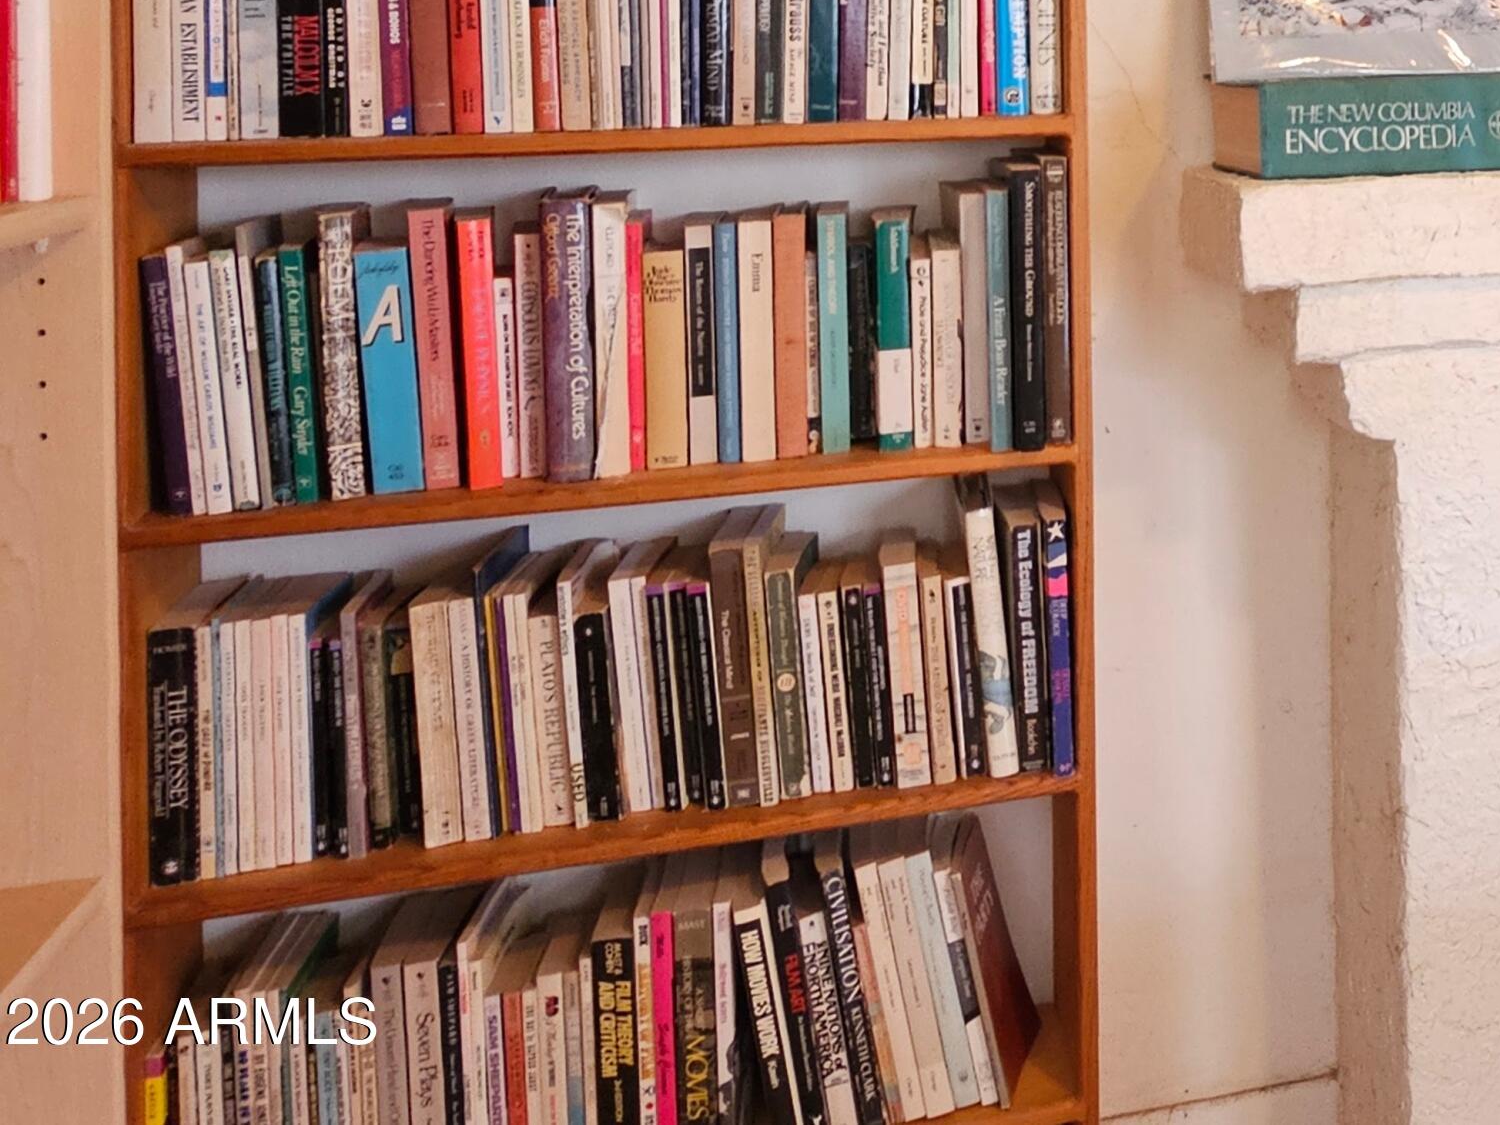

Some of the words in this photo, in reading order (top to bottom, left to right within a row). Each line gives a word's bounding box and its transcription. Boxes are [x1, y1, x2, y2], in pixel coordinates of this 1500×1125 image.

[281, 16, 292, 38] THE
[282, 44, 293, 64] FBI
[294, 15, 320, 82] MALCOLM
[180, 23, 199, 123] ESTABLISHMENT
[282, 69, 294, 96] FILE
[295, 85, 320, 96] X
[1287, 105, 1323, 125] THE
[1327, 103, 1375, 123] NEW
[1378, 101, 1475, 122] COLUMBIA
[1285, 124, 1476, 155] ENCYCLOPEDIA
[566, 213, 582, 242] The
[1025, 181, 1035, 245] SMOOTHING
[547, 213, 559, 256] Clifford
[283, 265, 299, 288] Left
[751, 253, 764, 293] Emma
[1025, 248, 1034, 268] THE
[285, 290, 299, 314] Out
[567, 246, 586, 352] Interpretation
[1025, 270, 1036, 316] GROUND
[287, 316, 299, 326] in
[361, 285, 403, 347] A
[287, 328, 301, 345] the
[290, 347, 305, 373] Rain
[567, 355, 587, 374] of
[290, 386, 308, 416] Gary
[570, 376, 588, 441] Cultures
[293, 418, 312, 455] Snyder
[1017, 530, 1031, 558] The
[1016, 561, 1033, 617] Ecology
[1021, 621, 1035, 636] of
[540, 641, 563, 704] PLATO'S
[1022, 639, 1038, 714] FREEDOM
[168, 685, 188, 725] THE
[168, 728, 188, 810] ODYSSEY
[544, 709, 566, 794] REPUBLIC
[571, 763, 585, 802] USED
[740, 930, 762, 963] HOW
[825, 876, 864, 1005] CIVILISATION
[784, 955, 801, 987] FILM
[805, 953, 822, 1010] NORTH
[815, 949, 833, 984] NINE
[599, 982, 614, 1009] AND
[616, 981, 631, 1012] FILM
[746, 966, 772, 1015] MOVIES
[789, 986, 805, 1014] ART
[416, 1012, 434, 1062] Seven
[822, 985, 842, 1049] NATIONS
[851, 1005, 871, 1064] KENNETH
[600, 1013, 617, 1078] CRITICISM
[617, 1015, 633, 1066] THEORY
[756, 1017, 780, 1058] WORK
[813, 1011, 834, 1078] AMERICA
[685, 1035, 709, 1120] MOVIES
[834, 1051, 848, 1070] of
[416, 1065, 437, 1108] Plays
[860, 1063, 876, 1103] CLARK
